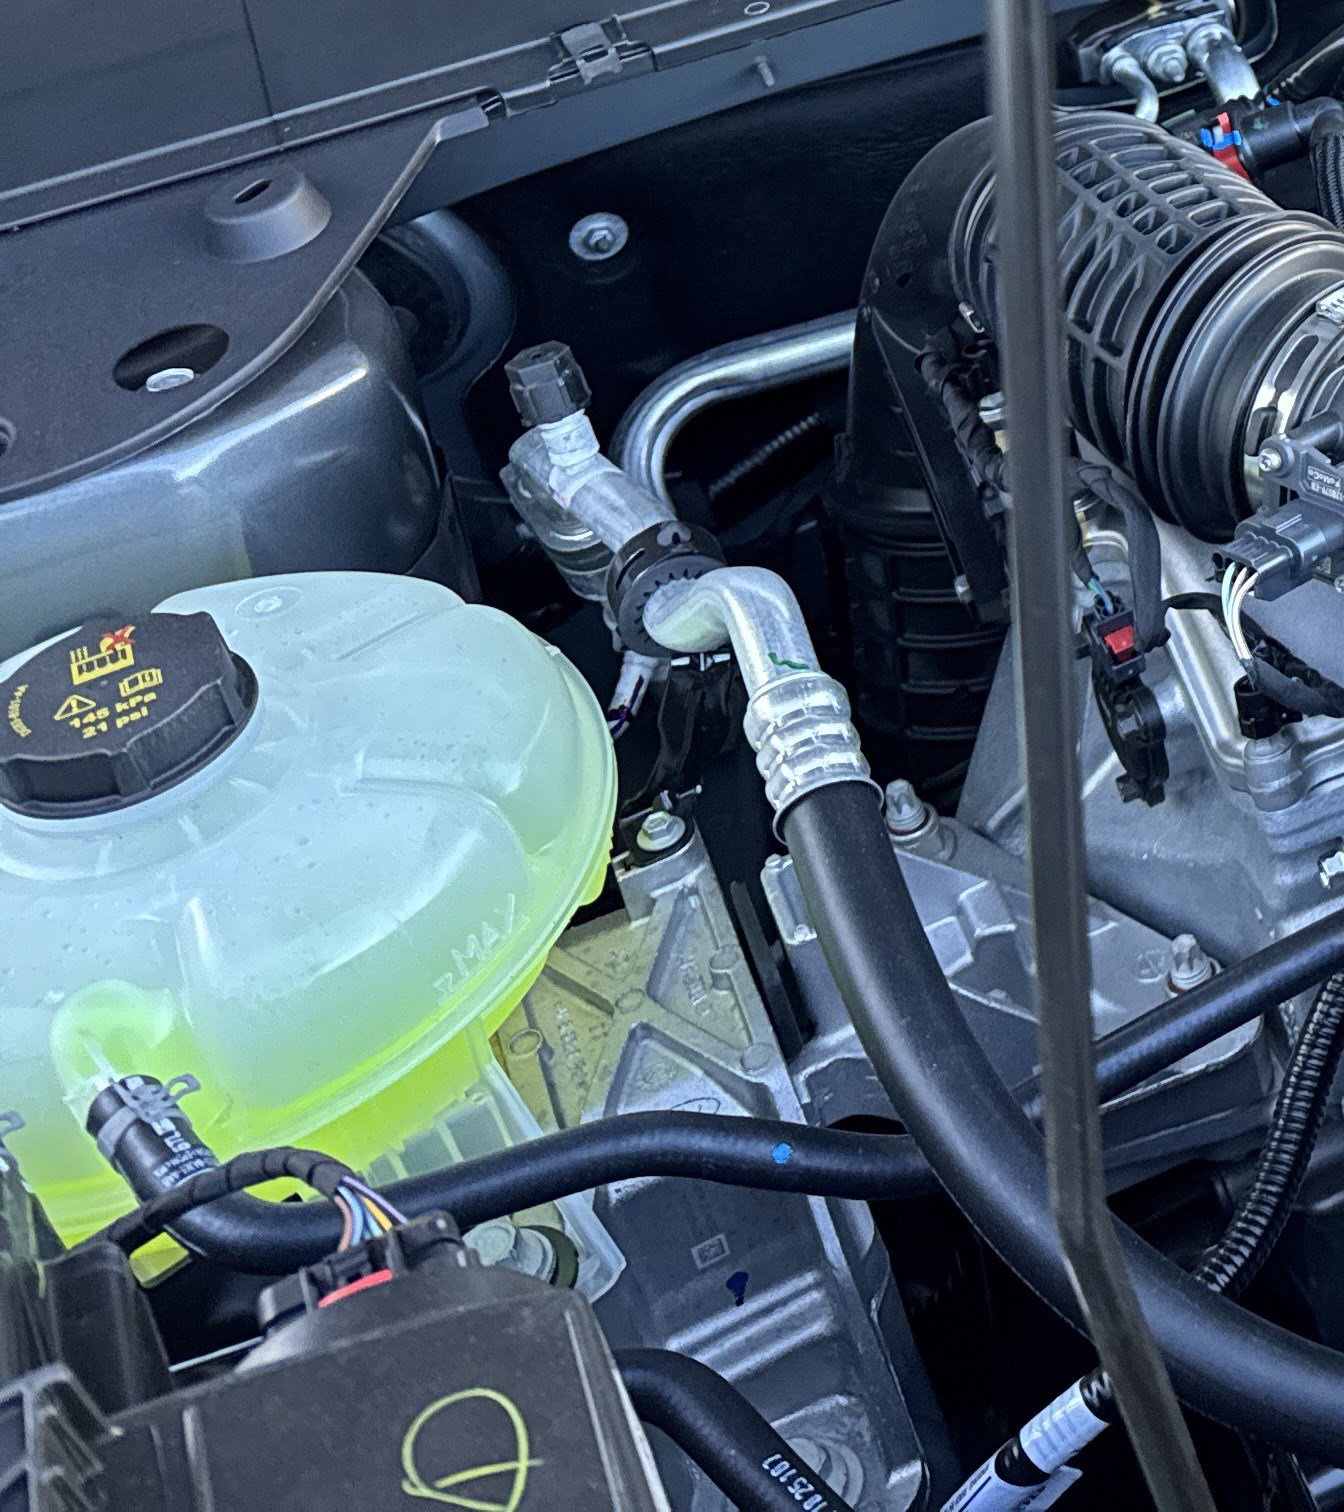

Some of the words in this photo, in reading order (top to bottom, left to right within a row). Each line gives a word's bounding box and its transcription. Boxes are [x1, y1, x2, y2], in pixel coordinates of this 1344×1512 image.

[114, 692, 157, 713] kPa
[82, 721, 108, 739] 21
[115, 706, 149, 729] psi
